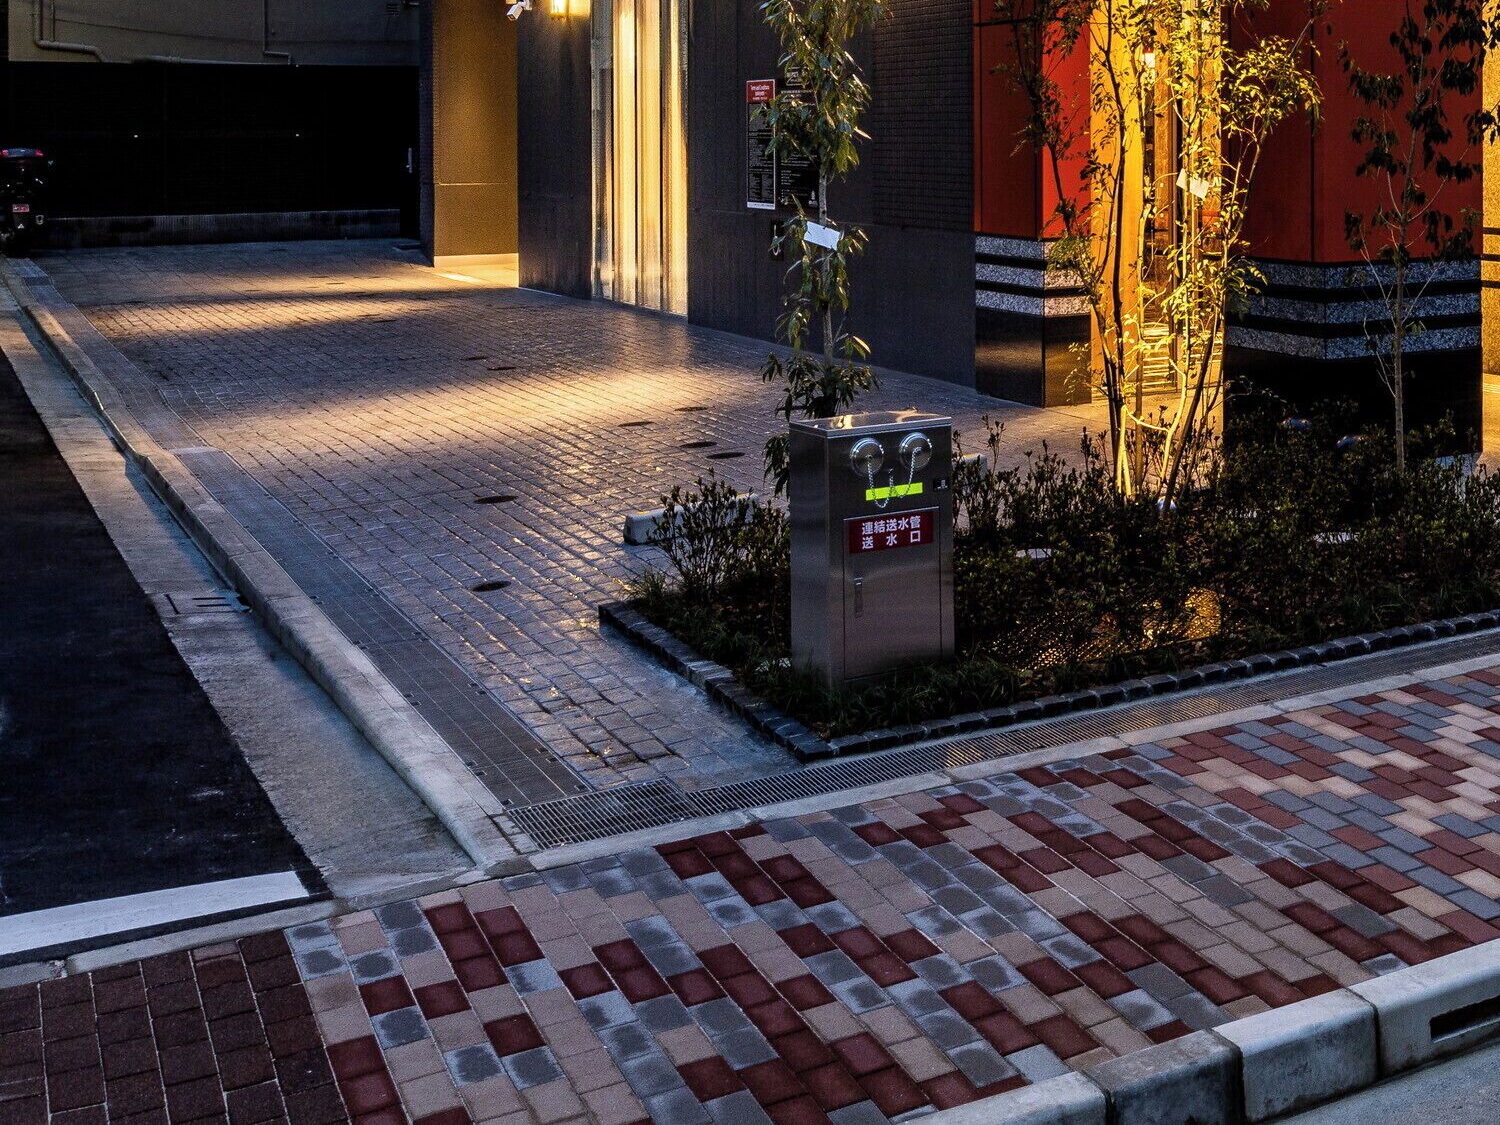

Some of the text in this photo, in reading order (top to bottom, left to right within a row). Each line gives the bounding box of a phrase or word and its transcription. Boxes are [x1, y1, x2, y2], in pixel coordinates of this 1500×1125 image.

[861, 515, 921, 536] 連結送水管
